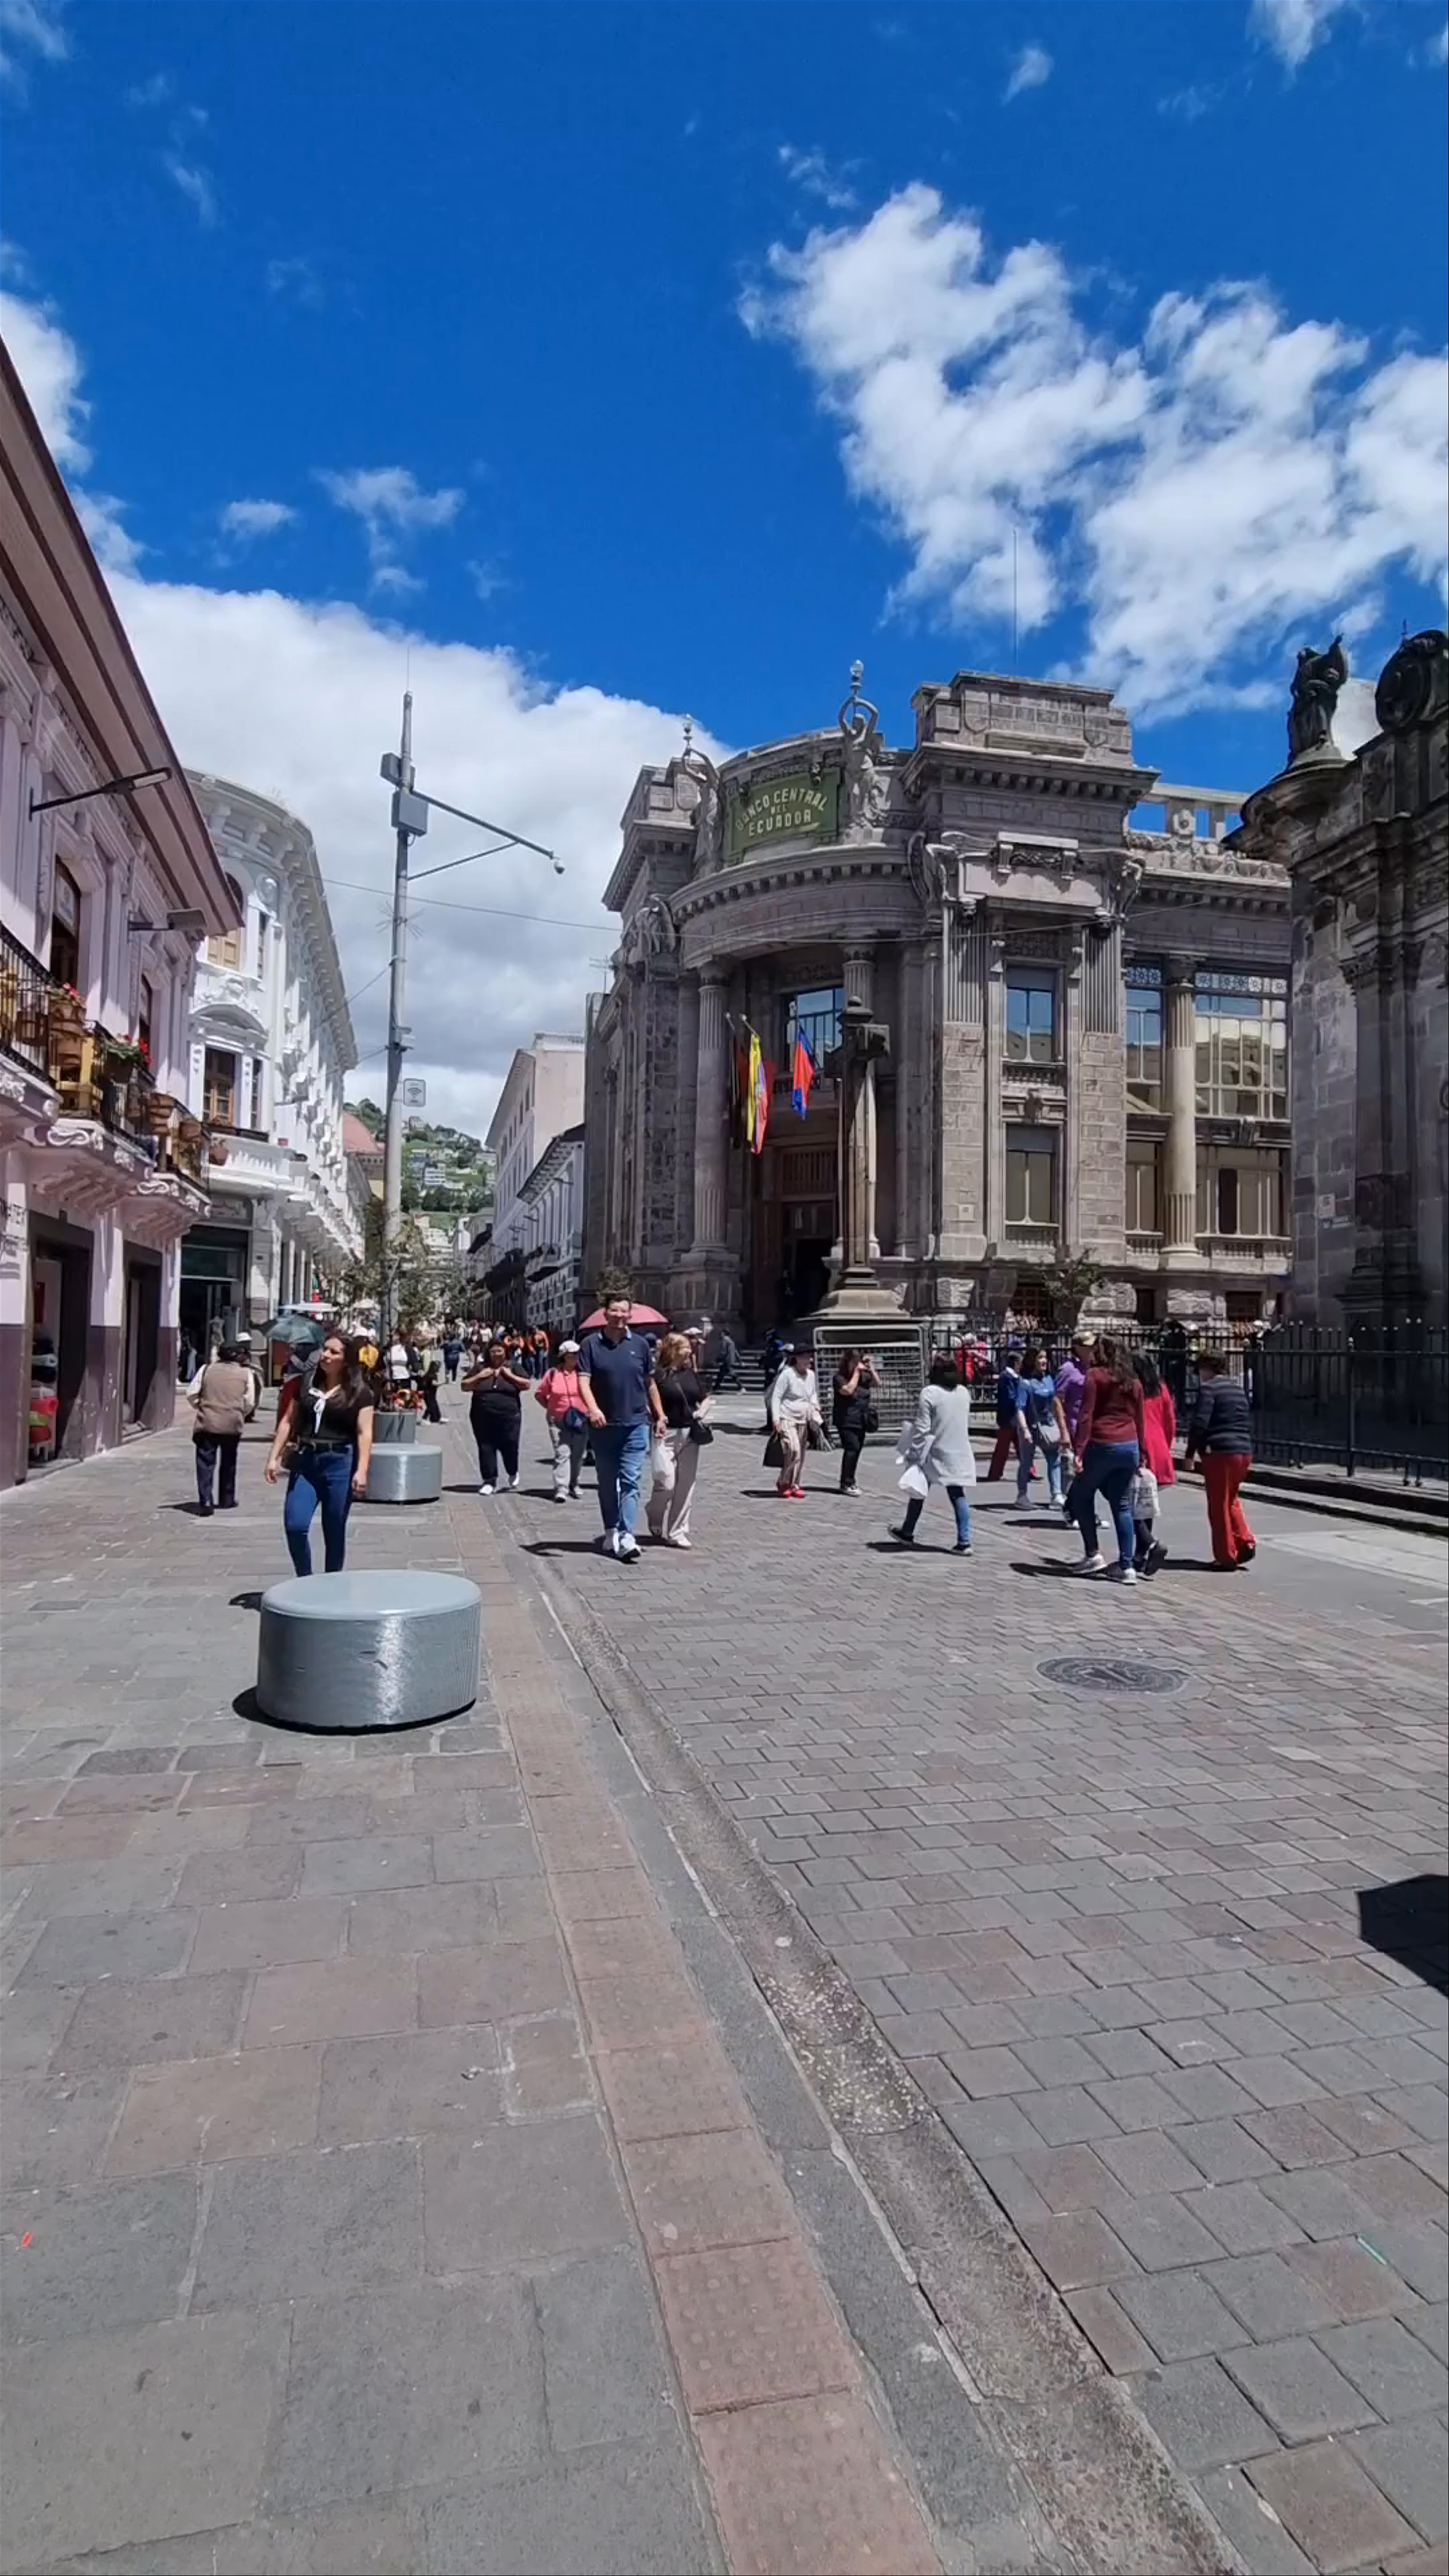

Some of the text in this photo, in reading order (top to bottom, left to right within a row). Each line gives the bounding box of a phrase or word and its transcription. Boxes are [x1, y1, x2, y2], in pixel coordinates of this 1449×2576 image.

[736, 788, 828, 830] BANCO CENTRAL
[749, 809, 811, 837] ECUADOR
